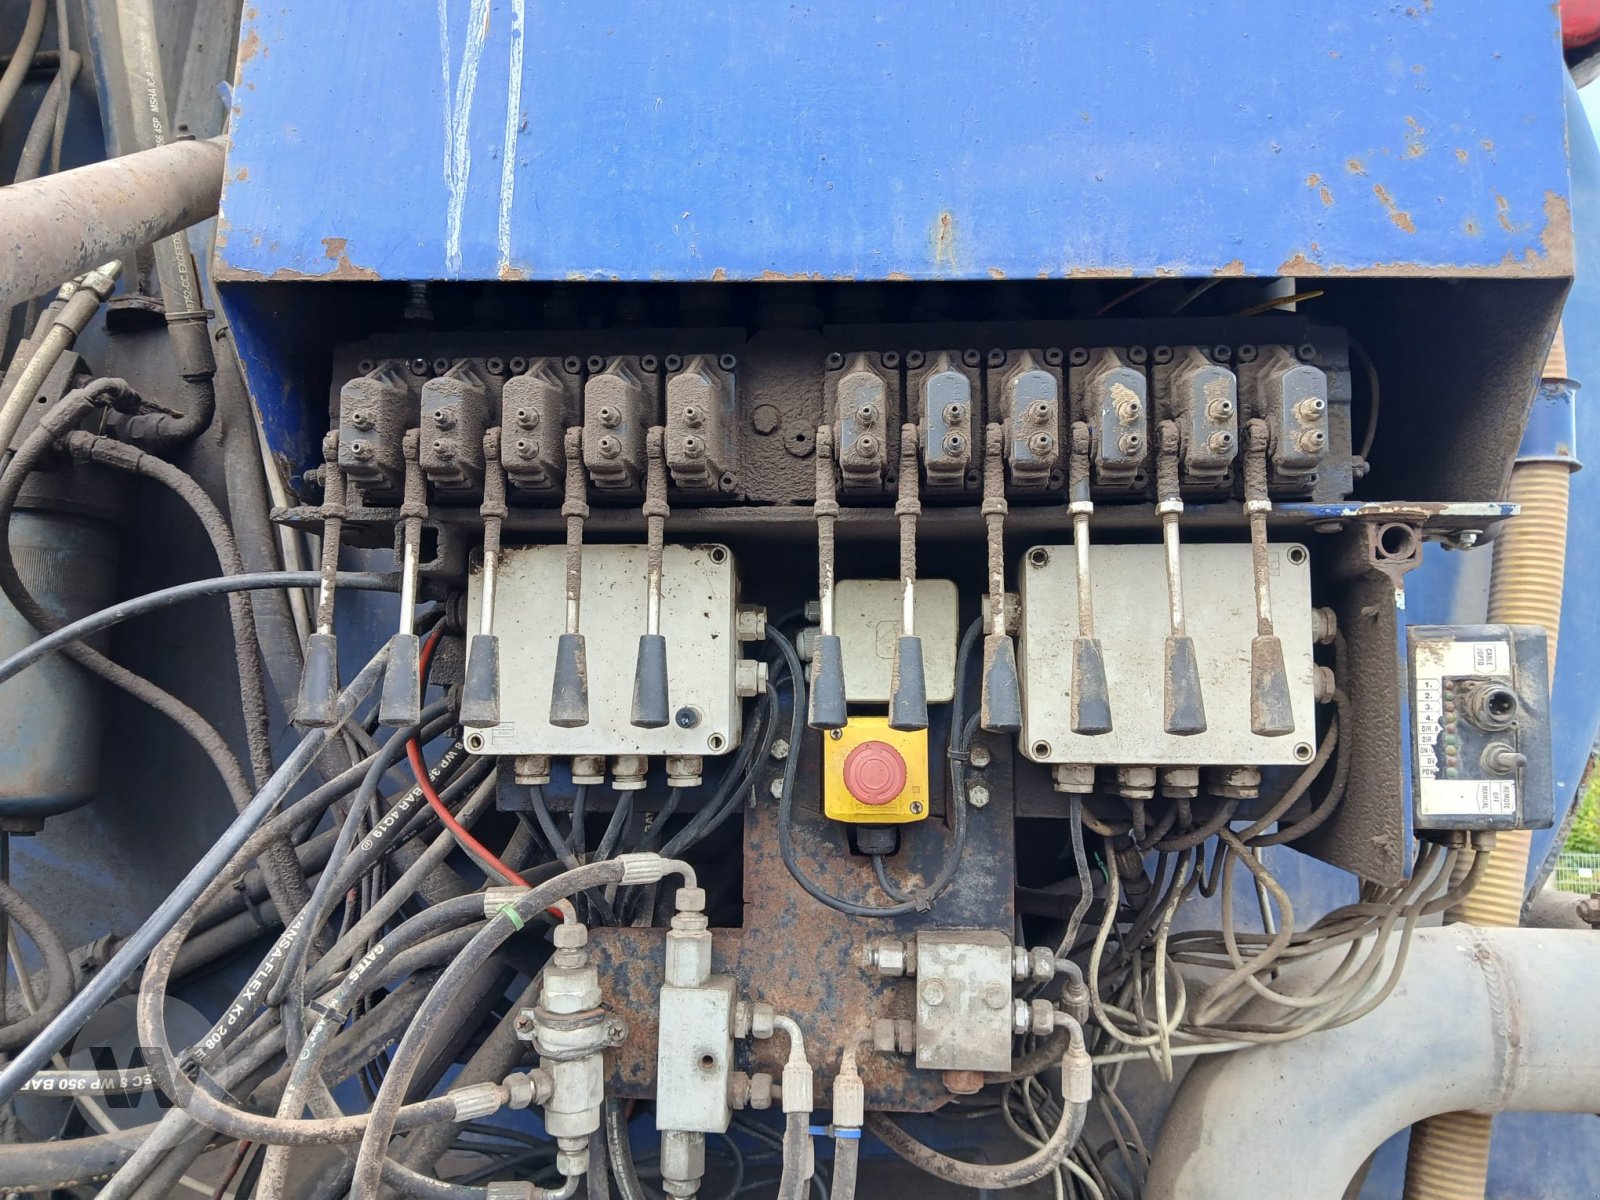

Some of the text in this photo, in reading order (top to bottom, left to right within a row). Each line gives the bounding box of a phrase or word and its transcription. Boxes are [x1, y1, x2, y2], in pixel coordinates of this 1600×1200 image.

[148, 89, 159, 112] MSHA
[440, 751, 458, 768] WP
[399, 787, 423, 810] BAR
[373, 811, 399, 838] 4Q19
[349, 943, 384, 981] GATES
[227, 1004, 245, 1025] KP
[205, 1025, 227, 1049] 208
[58, 1079, 86, 1090] 350
[90, 1078, 115, 1089] WP
[120, 1077, 128, 1088] 8
